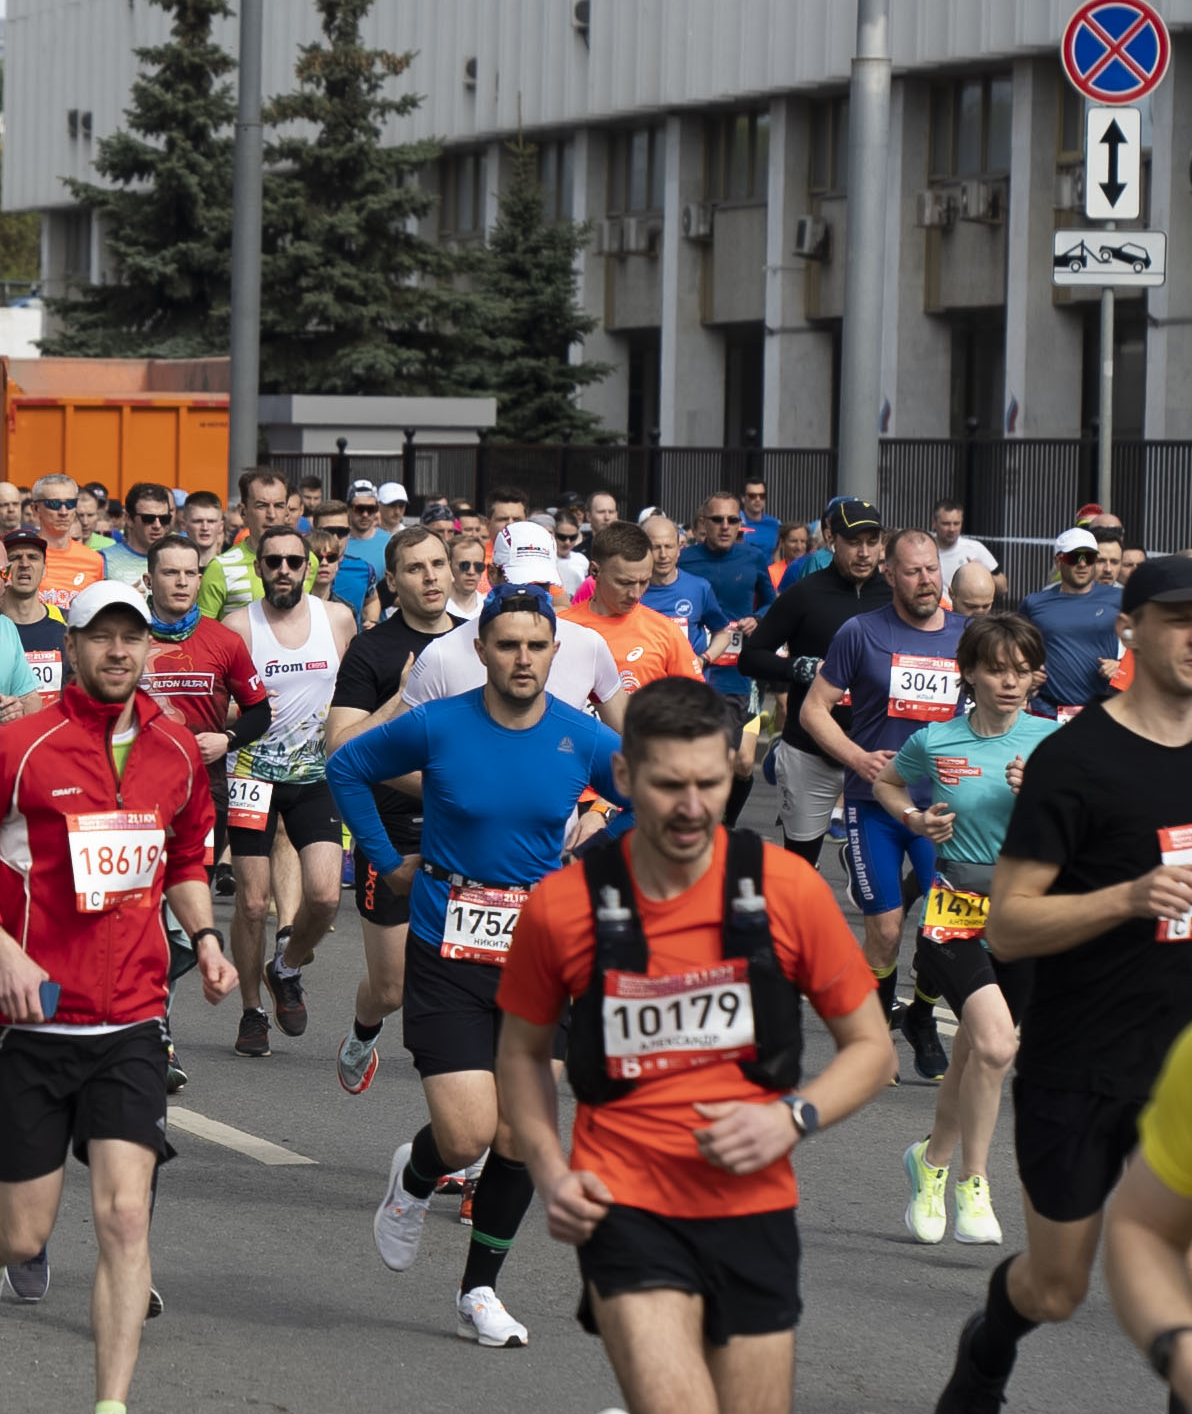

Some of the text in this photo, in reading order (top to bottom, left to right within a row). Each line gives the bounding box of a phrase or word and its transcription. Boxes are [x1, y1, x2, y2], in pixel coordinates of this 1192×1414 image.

[265, 661, 303, 677] grom
[153, 679, 209, 689] ELTON ULTRA
[901, 672, 948, 694] 3041
[51, 787, 77, 797] CRAFT
[229, 781, 260, 802] 616
[79, 845, 160, 875] 18619
[849, 829, 875, 900] ИЗМАЙЛОВО
[453, 906, 518, 937] 1754
[473, 937, 510, 949] НИКИТА
[614, 991, 740, 1040] 10179
